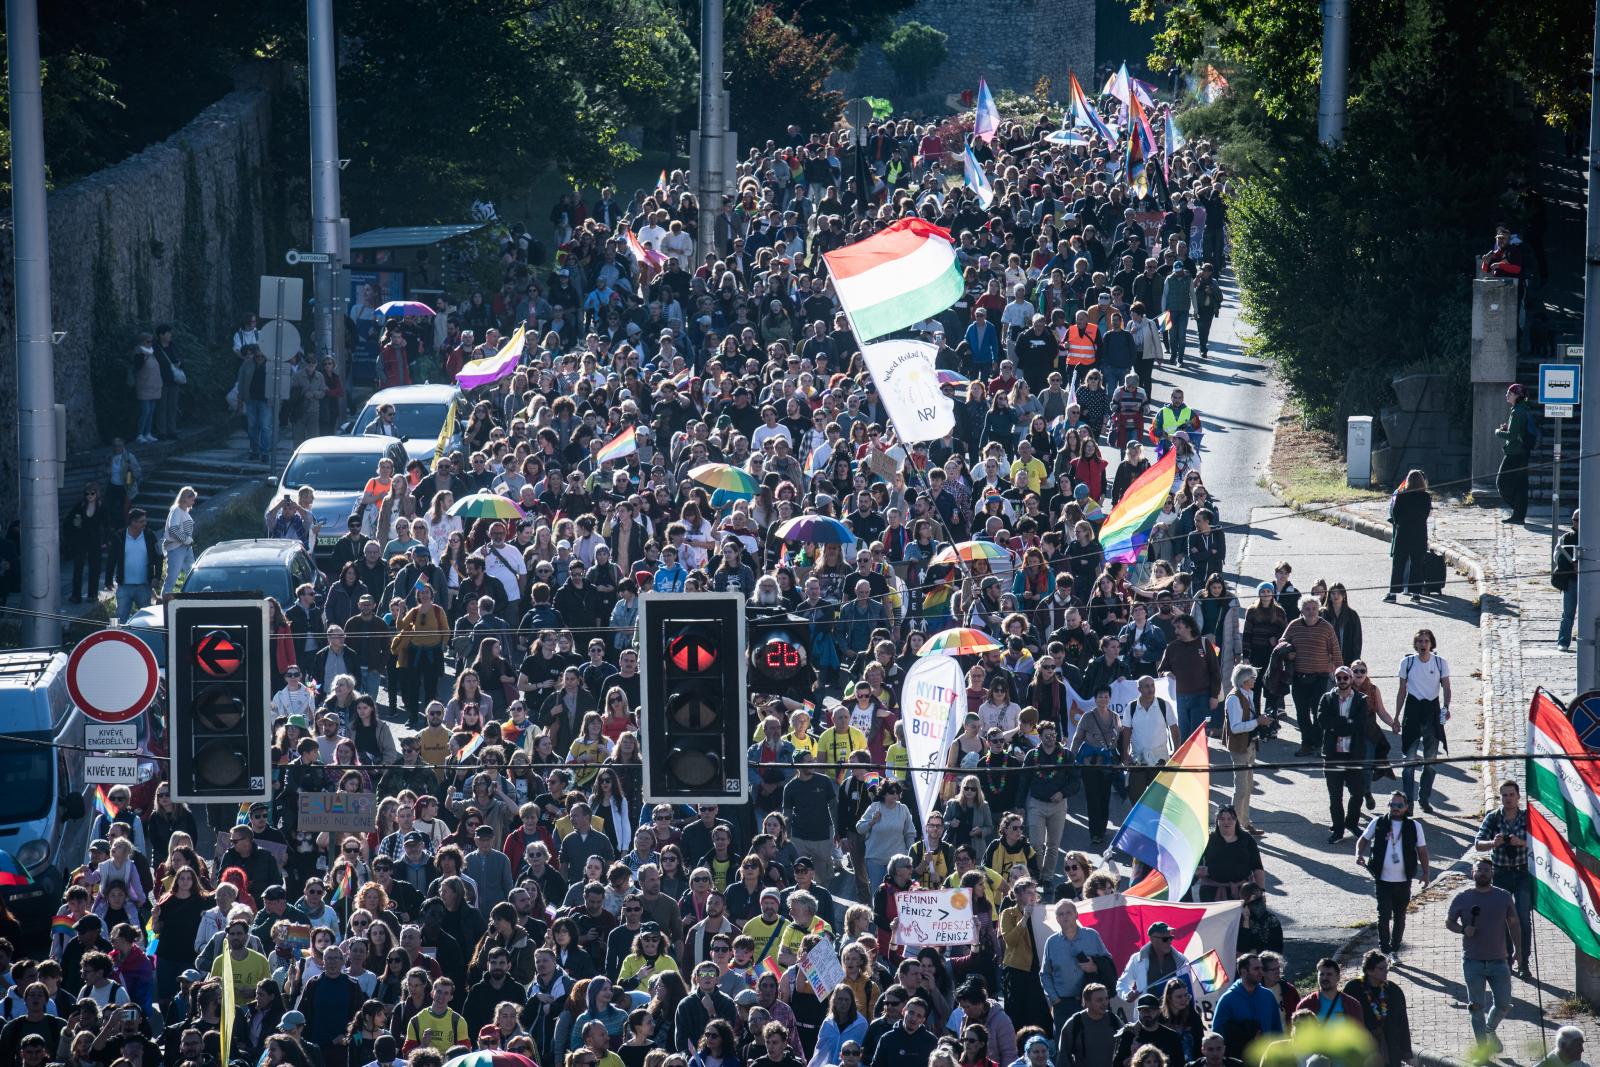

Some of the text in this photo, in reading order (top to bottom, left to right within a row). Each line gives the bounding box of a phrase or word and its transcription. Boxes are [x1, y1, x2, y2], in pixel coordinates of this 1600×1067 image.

[768, 642, 799, 667] 26
[99, 728, 123, 736] KIVÉVE
[88, 737, 135, 745] ENGEDÉLLYEL
[86, 764, 135, 777] KIVÉVE TAXI
[251, 779, 263, 789] 24
[727, 780, 739, 790] 23
[897, 894, 938, 905] FEMININ
